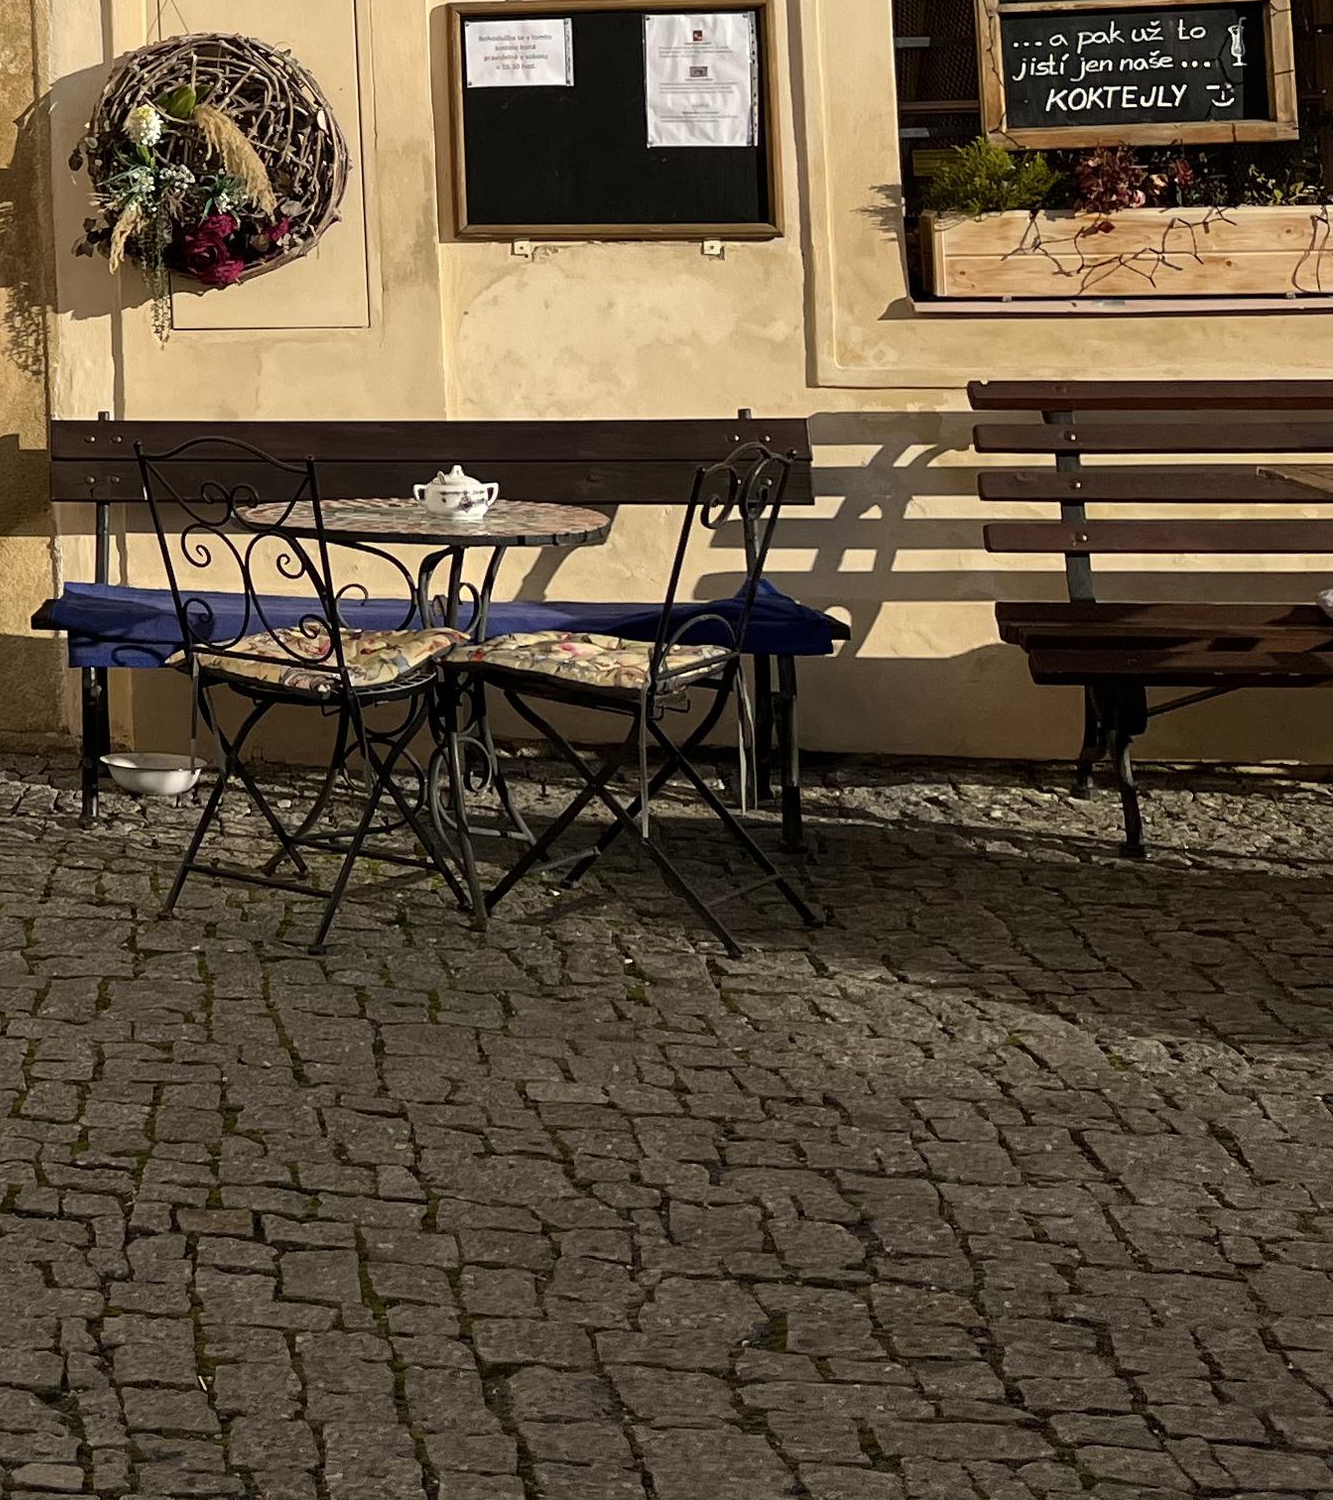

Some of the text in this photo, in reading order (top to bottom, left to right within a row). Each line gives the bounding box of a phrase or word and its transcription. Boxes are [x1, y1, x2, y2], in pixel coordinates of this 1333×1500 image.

[1077, 21, 1125, 54] pak
[1131, 21, 1164, 42] už
[1177, 19, 1207, 40] to
[1012, 53, 1069, 82] jistí
[1070, 56, 1113, 82] jen
[1119, 51, 1174, 72] naše
[1045, 84, 1187, 112] KOKTEJLY
